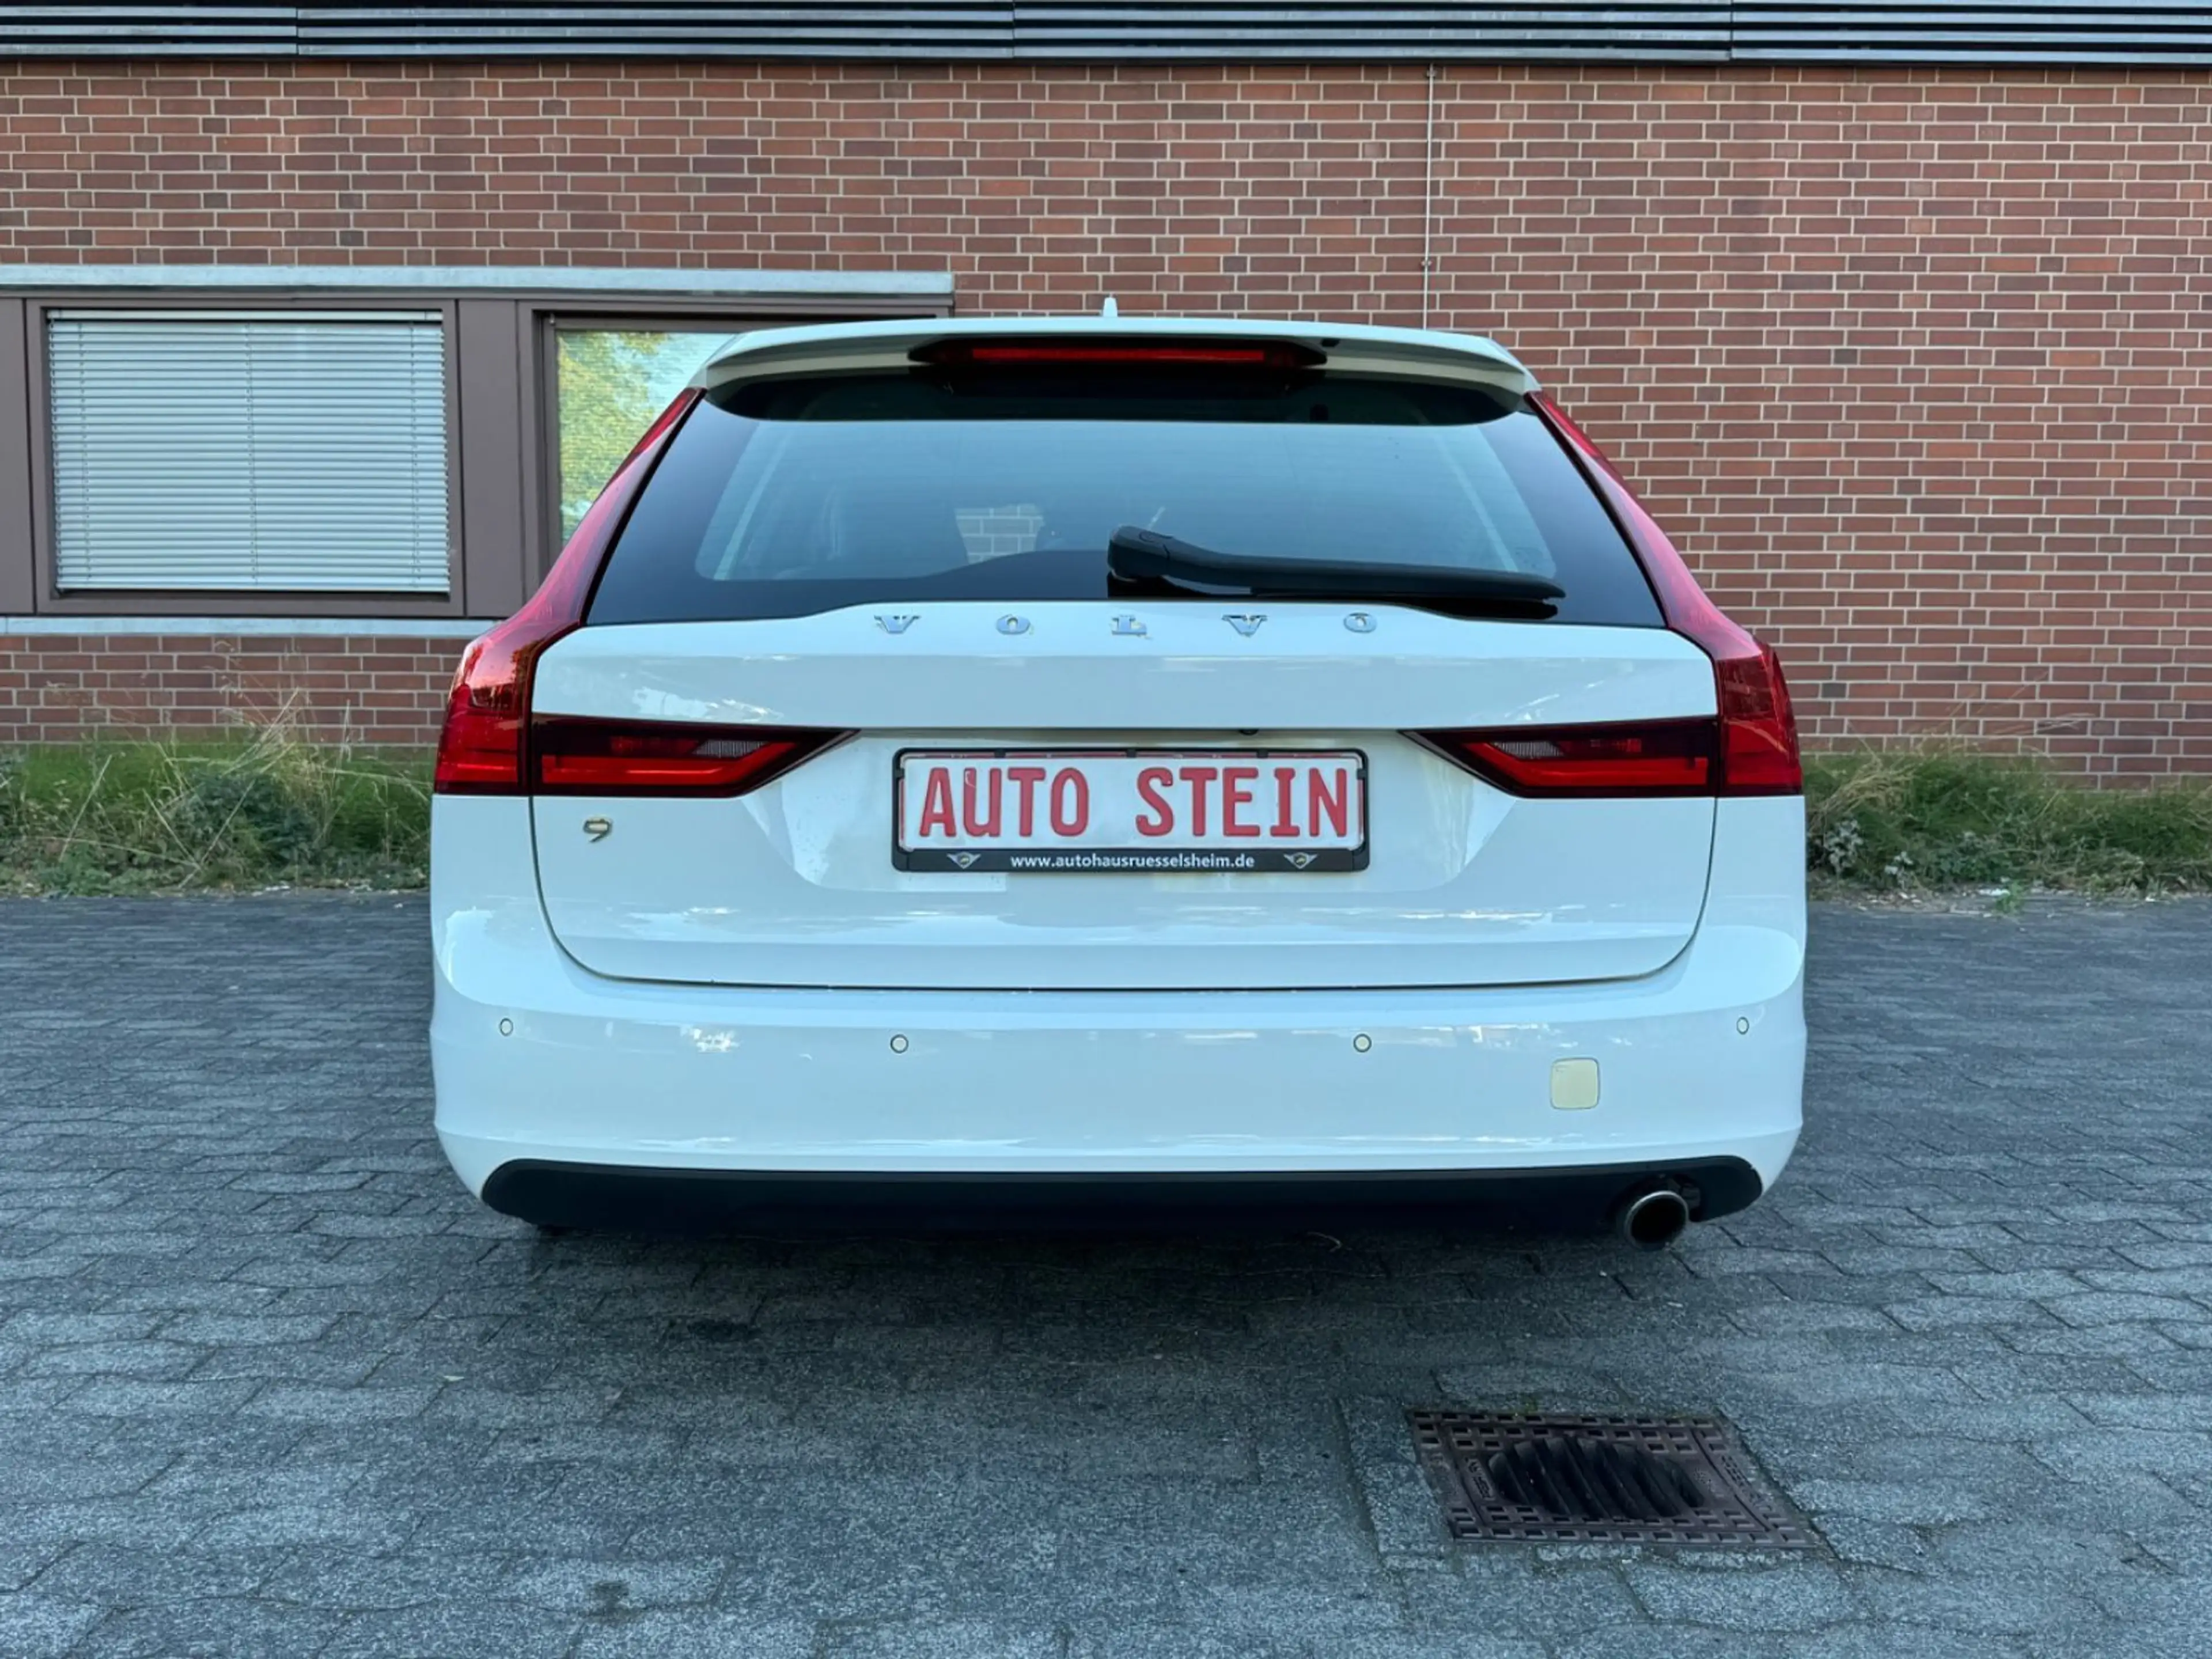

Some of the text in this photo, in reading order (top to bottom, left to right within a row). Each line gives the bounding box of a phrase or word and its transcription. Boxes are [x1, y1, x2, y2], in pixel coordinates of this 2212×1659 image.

[874, 613, 1377, 637] VOLVO
[919, 767, 1347, 837] AUTO STEIN
[1010, 854, 1255, 868] www.autohausruesselsheim.de
